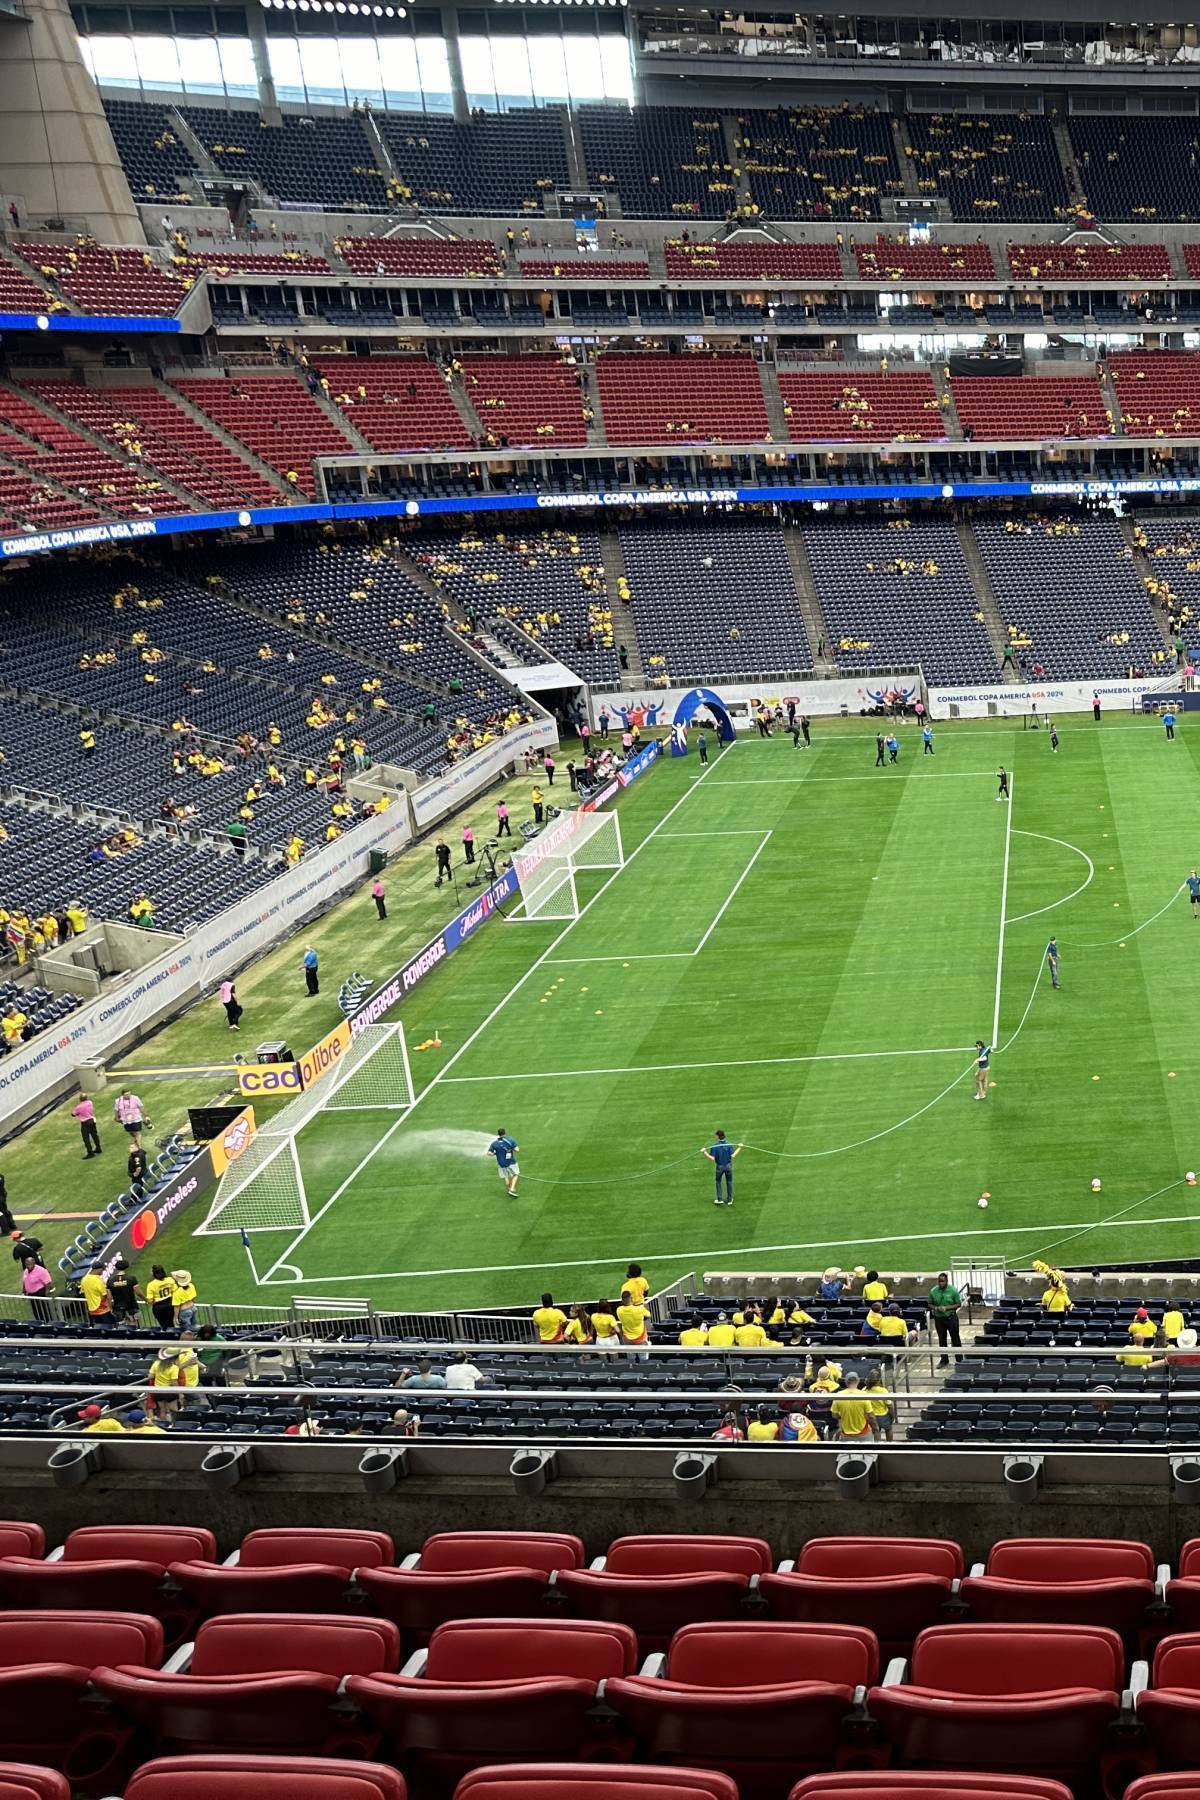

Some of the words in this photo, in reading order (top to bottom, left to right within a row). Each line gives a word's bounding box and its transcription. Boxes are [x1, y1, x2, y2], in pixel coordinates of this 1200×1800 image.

[537, 494, 603, 507] CONMEBOL
[604, 493, 635, 505] COPA
[635, 491, 686, 504] AMERICA
[687, 490, 709, 502] USA
[710, 489, 738, 501] 2024
[1031, 482, 1087, 494] CONMEBOL
[1088, 481, 1115, 493] COPA
[1115, 481, 1160, 492] AMERICA
[1161, 480, 1179, 491] USA
[2, 537, 52, 556] CONMEBOL
[52, 532, 74, 550] COPA
[74, 526, 111, 545] AMERICA
[110, 524, 131, 538] USA
[131, 521, 157, 536] 2024
[937, 695, 978, 703] CONMEBOL
[999, 693, 1031, 701] AMERICA
[1093, 687, 1132, 695] CONMEBOL
[206, 939, 232, 959] CONMEBOL
[231, 929, 245, 944] COPA
[244, 916, 262, 935] AMERICA
[402, 937, 447, 991] POWERADE
[99, 995, 133, 1022] CONMEBOL
[132, 985, 147, 1000] COPA
[146, 969, 170, 990] AMERICA
[168, 963, 181, 975] USA
[179, 954, 193, 969] 2024
[351, 979, 402, 1038] POWERADE
[10, 1063, 30, 1082] COPA
[29, 1044, 59, 1070] AMERICA
[57, 1035, 72, 1049] USA
[70, 1025, 87, 1041] 2024
[312, 1037, 341, 1075] libre
[156, 1176, 198, 1224] priceless
